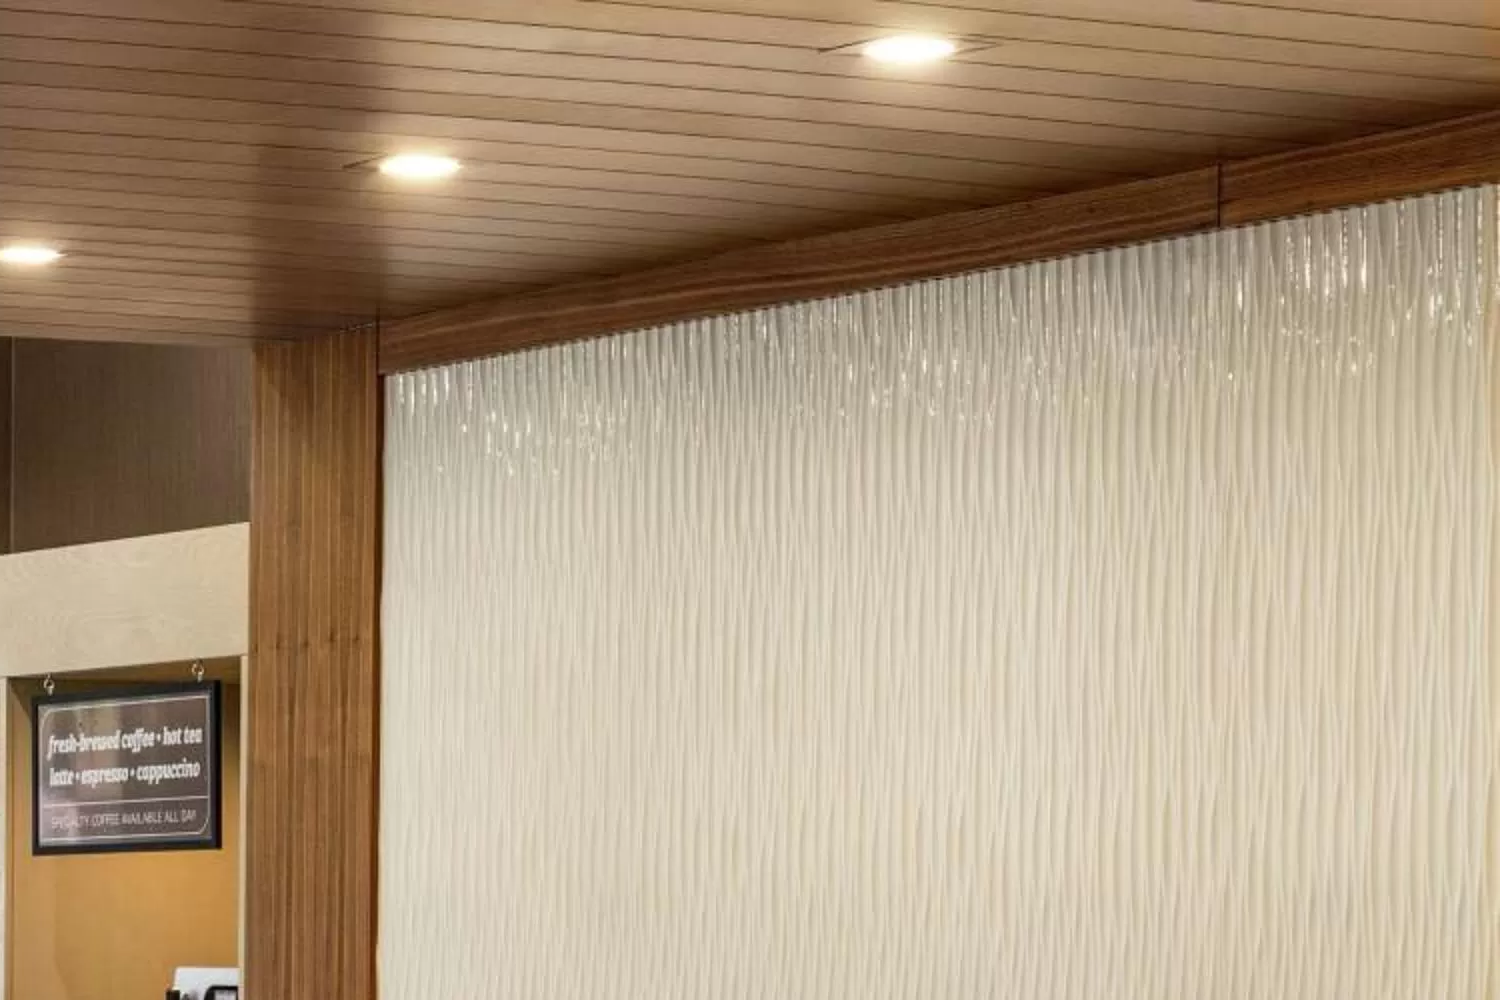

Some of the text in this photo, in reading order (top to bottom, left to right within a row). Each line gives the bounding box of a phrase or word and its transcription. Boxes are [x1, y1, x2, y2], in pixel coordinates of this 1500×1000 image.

[47, 726, 203, 761] fresh-brewed coffee hot tea
[49, 757, 201, 788] latte espresso cappuccino
[90, 812, 121, 827] COFFEE
[121, 810, 162, 826] AVAILABLE
[165, 809, 179, 824] ALL
